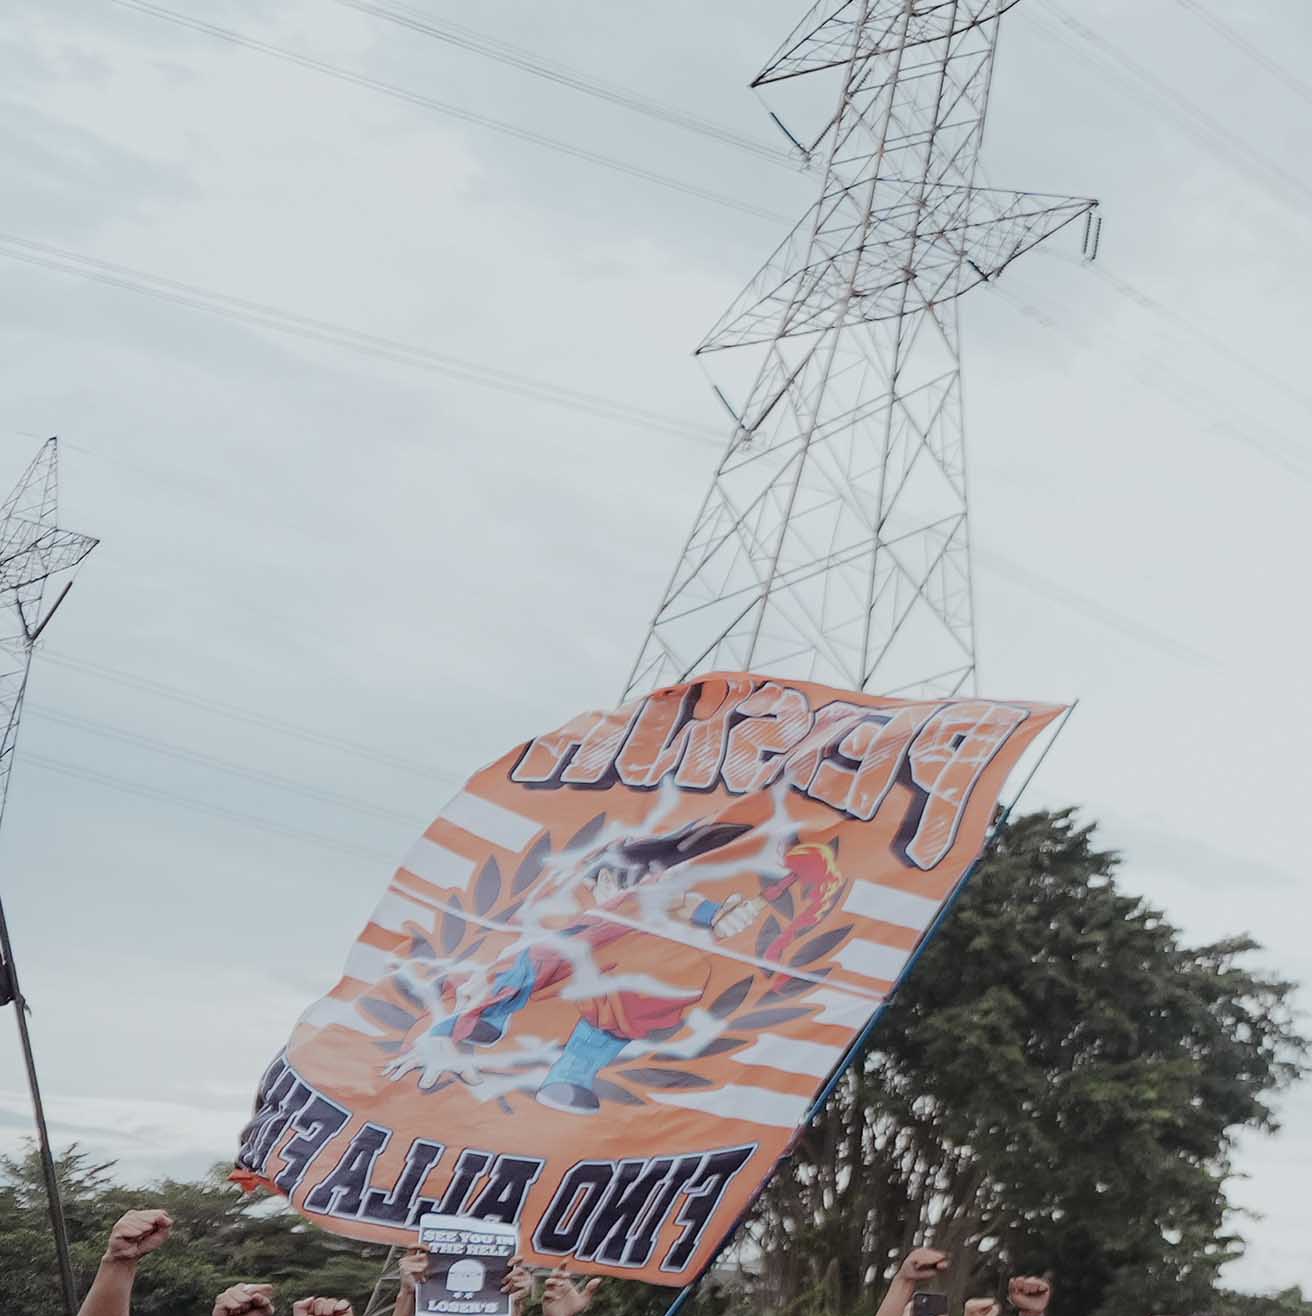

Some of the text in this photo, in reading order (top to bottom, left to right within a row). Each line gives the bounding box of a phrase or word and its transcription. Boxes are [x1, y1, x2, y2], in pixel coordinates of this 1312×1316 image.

[423, 1229, 459, 1242] SEE
[459, 1231, 496, 1244] YOU
[429, 1242, 512, 1257] THE HELL
[427, 1299, 498, 1313] LOSER'S
